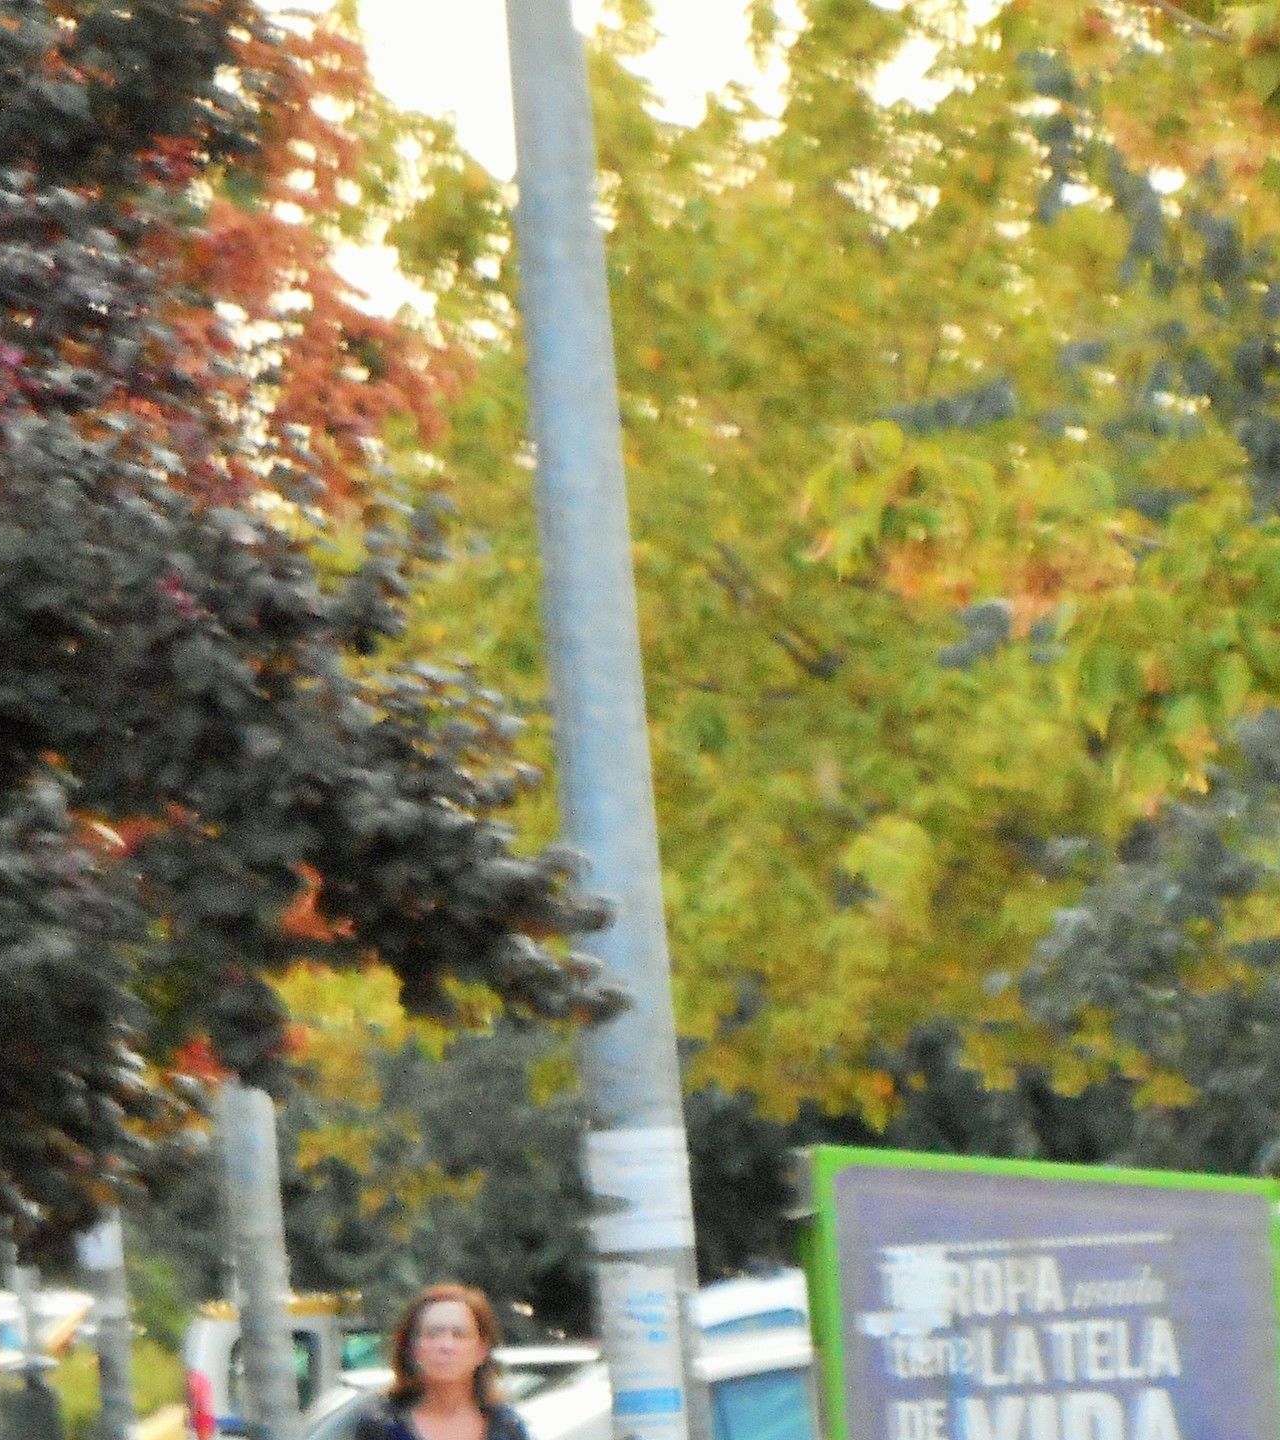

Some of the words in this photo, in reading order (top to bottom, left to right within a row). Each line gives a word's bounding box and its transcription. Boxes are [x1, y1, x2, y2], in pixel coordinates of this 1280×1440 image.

[944, 1256, 1064, 1315] ROPA
[980, 1325, 1045, 1386] LA
[1048, 1316, 1183, 1381] TELA
